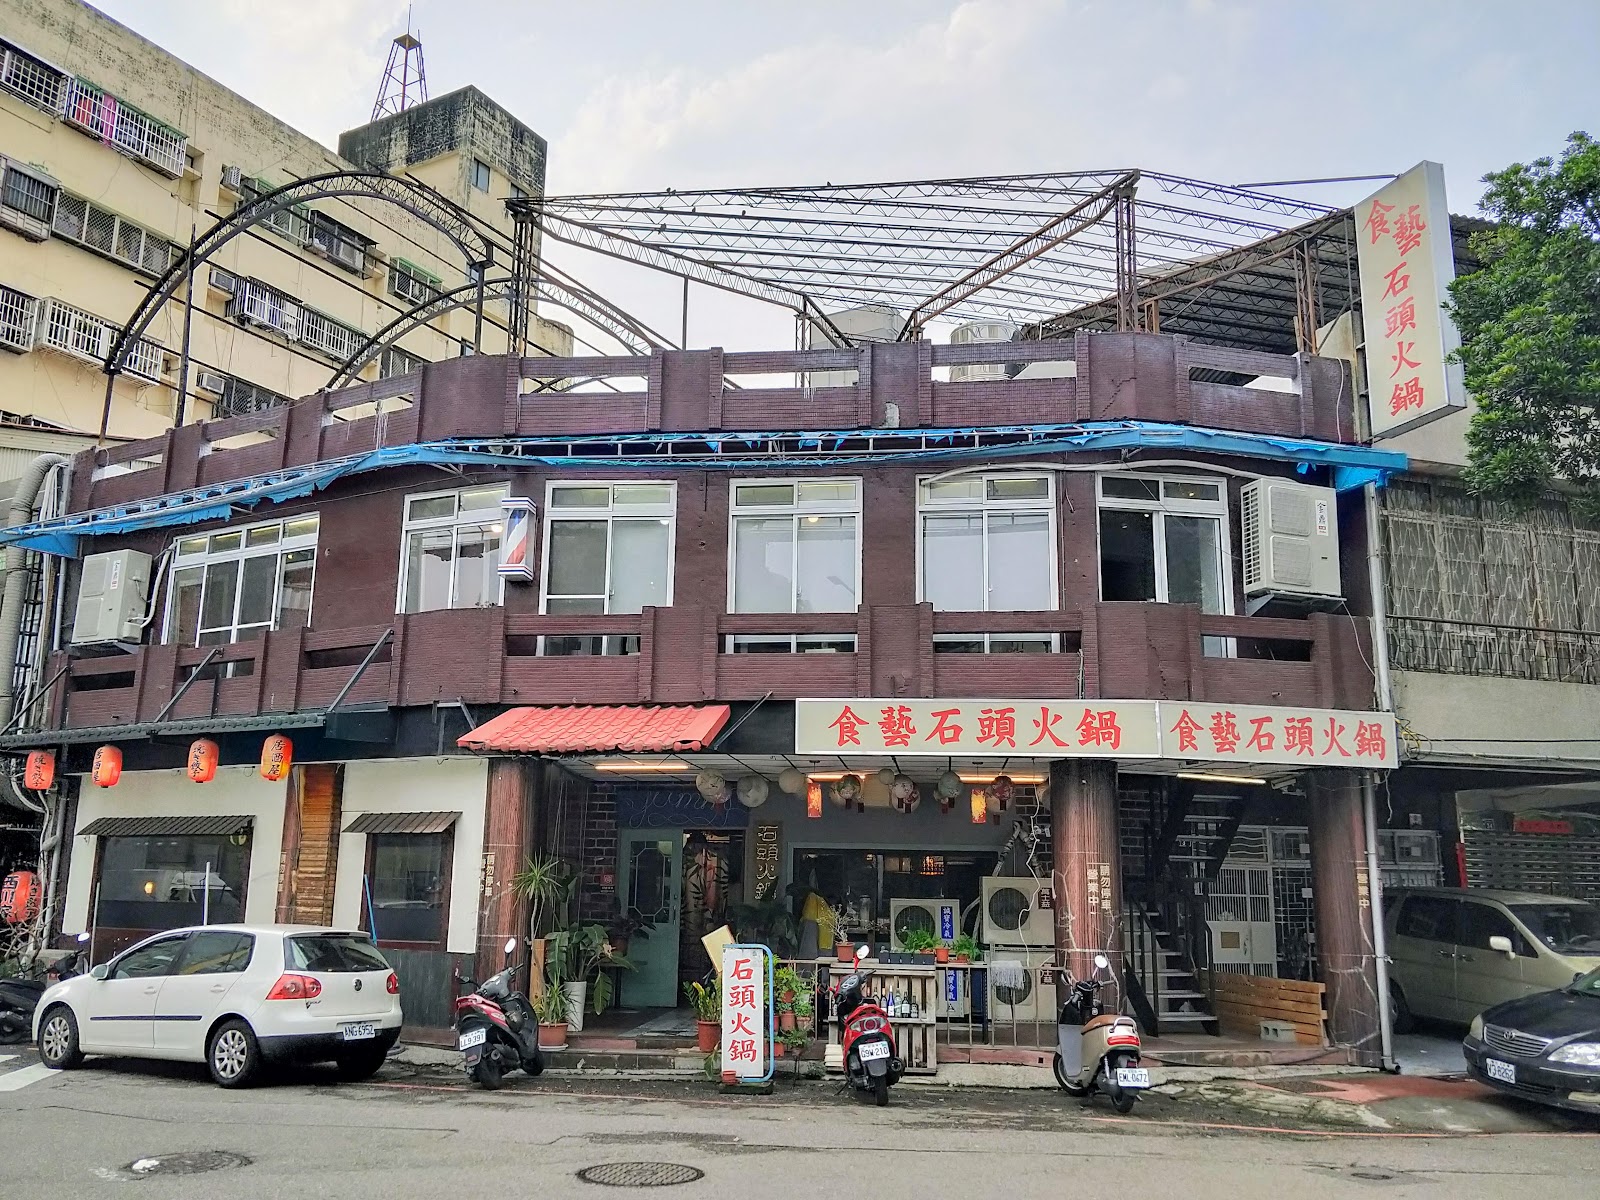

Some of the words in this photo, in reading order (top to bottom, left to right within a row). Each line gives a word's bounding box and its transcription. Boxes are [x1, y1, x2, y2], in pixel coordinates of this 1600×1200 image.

[1362, 199, 1427, 257] 食藝
[1379, 261, 1425, 417] 石頭火鍋
[828, 705, 1122, 749] 食藝石頭火鍋
[1170, 709, 1387, 760] 食藝石頭火鍋
[268, 740, 286, 776] 居酒屋
[1087, 869, 1099, 906] 營業中
[1100, 865, 1111, 910] 請勿停車
[728, 958, 757, 1062] 石頭火鍋
